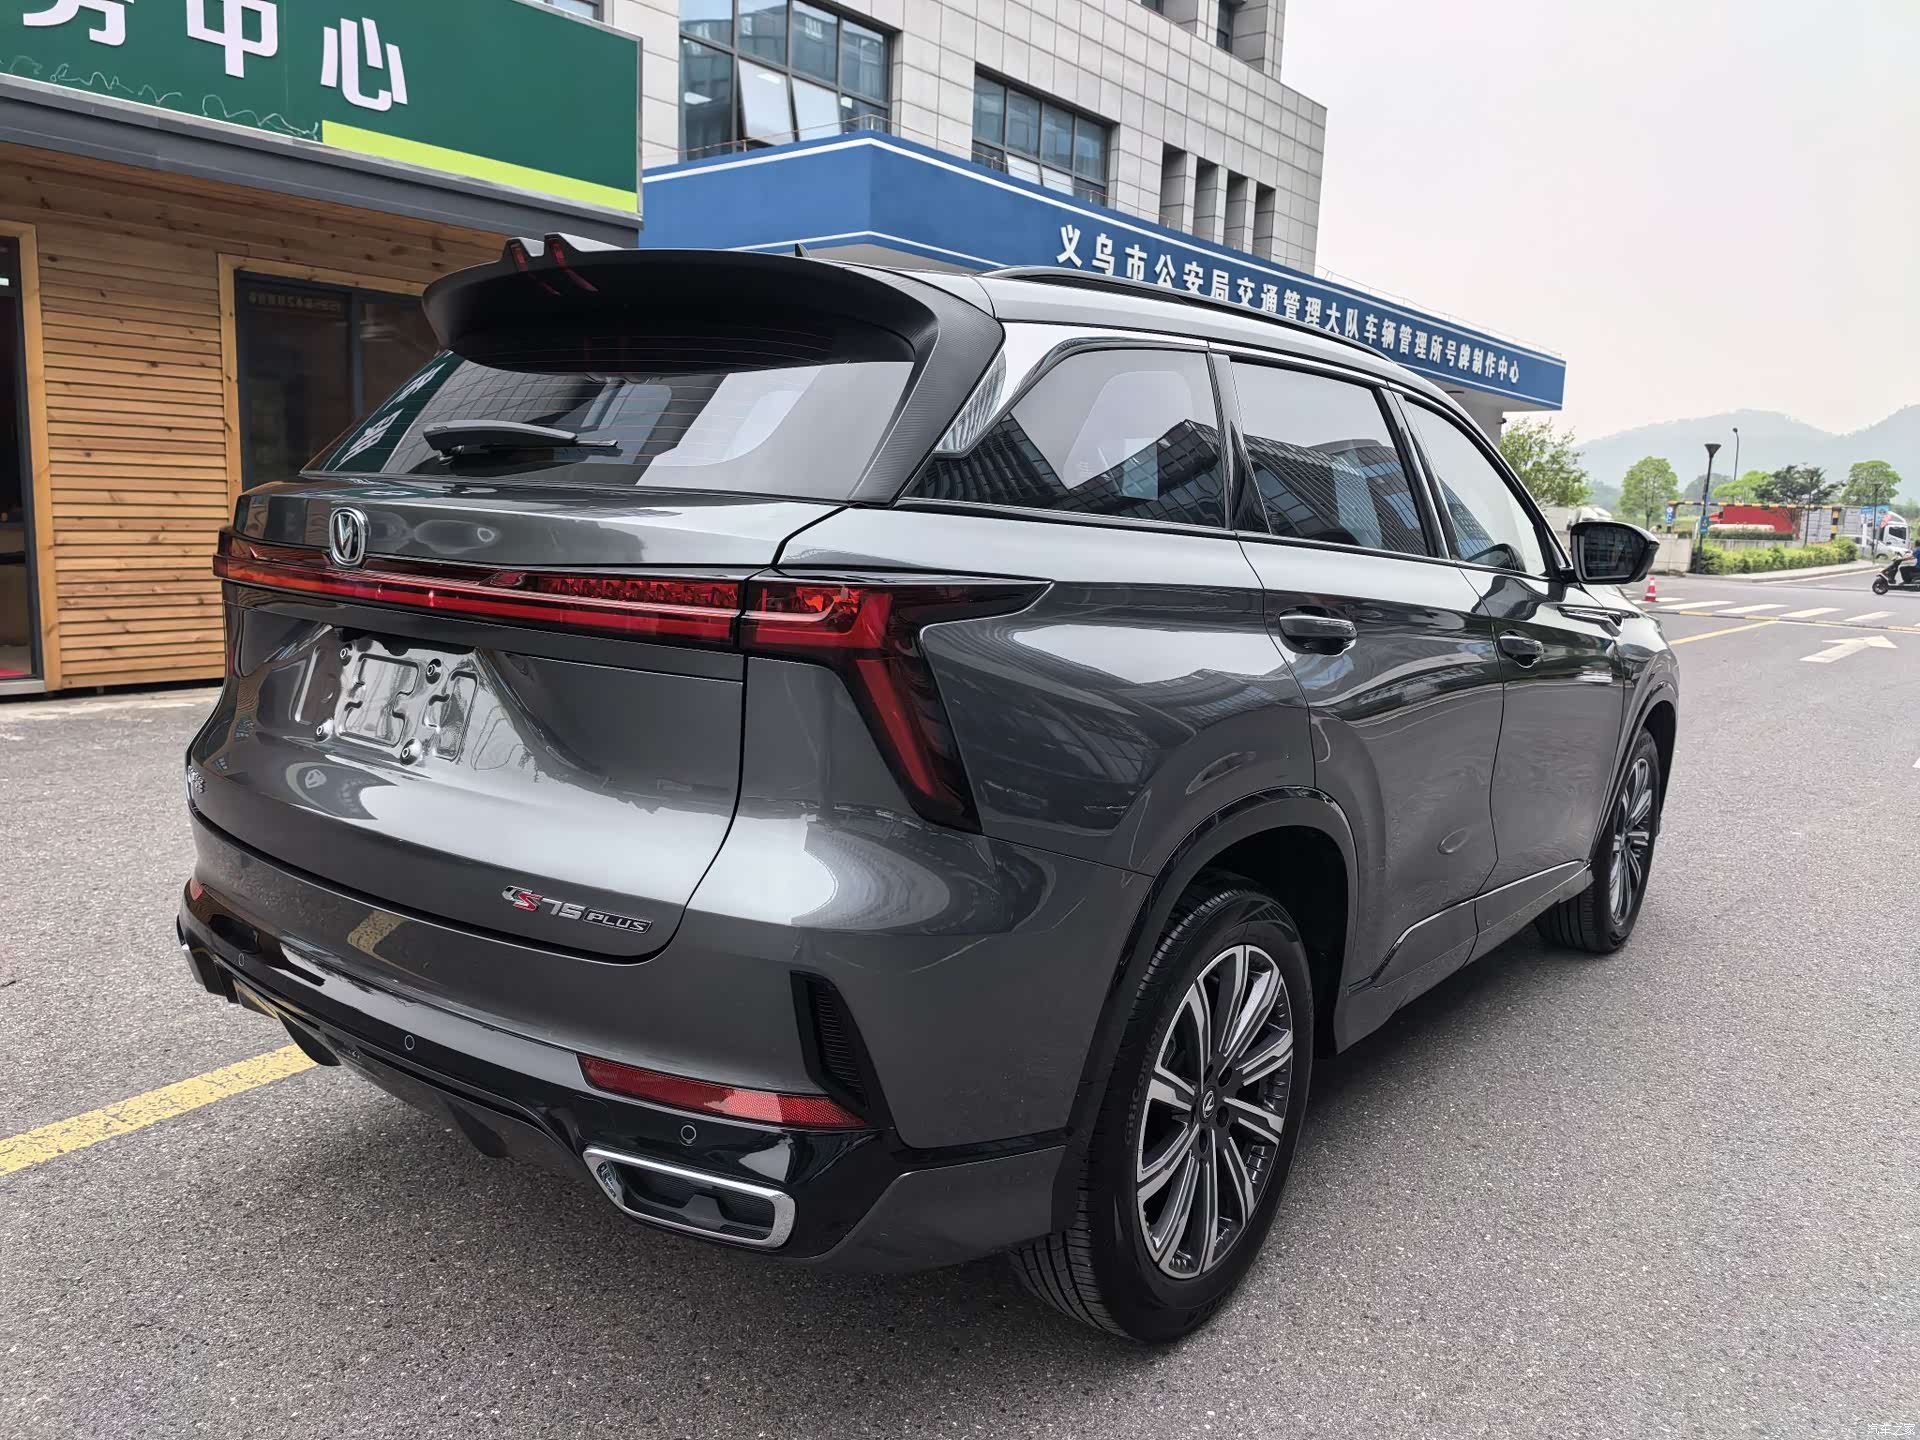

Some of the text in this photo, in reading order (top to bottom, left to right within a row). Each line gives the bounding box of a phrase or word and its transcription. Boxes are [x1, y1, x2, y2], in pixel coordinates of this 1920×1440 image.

[1056, 224, 1519, 384] 义乌市公安局交通管理大队车辆管理所号牌制作中心
[501, 885, 650, 933] CS75 PLUS
